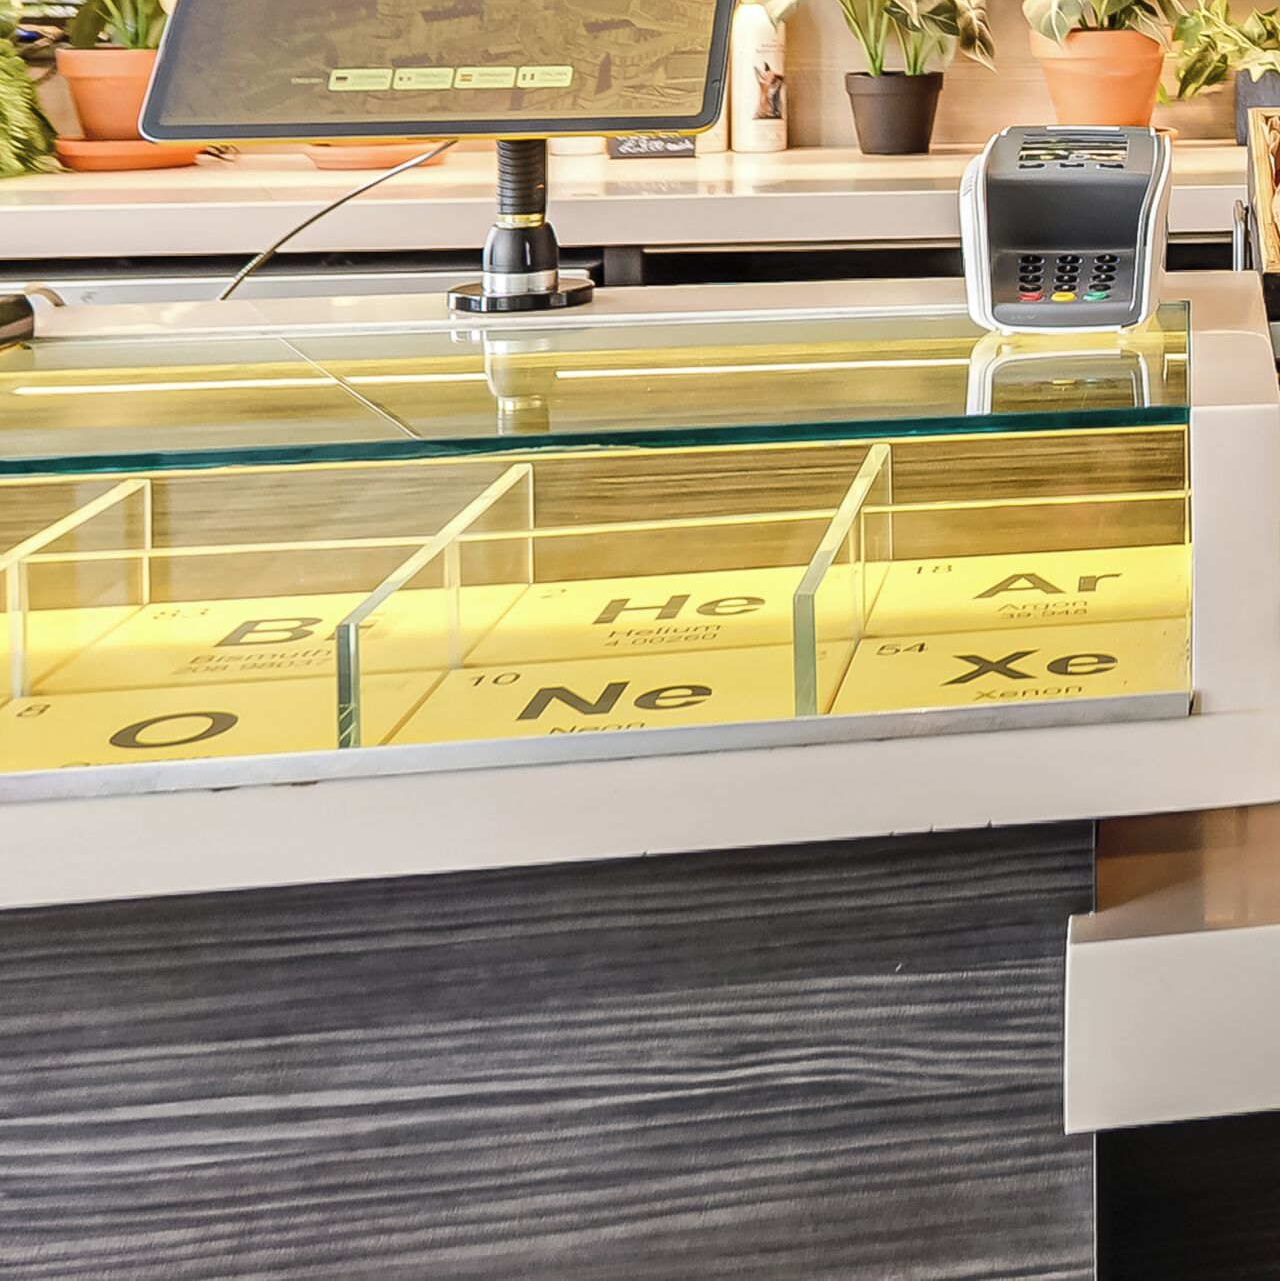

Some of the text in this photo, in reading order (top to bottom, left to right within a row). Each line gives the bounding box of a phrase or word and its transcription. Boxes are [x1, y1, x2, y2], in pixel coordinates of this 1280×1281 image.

[973, 572, 1123, 600] Ar
[592, 594, 766, 625] He
[997, 600, 1088, 612] Argon
[607, 624, 721, 638] Helium
[876, 642, 928, 656] 54
[940, 649, 1118, 687] Xe
[469, 672, 521, 687] 10
[515, 681, 712, 721] Ne
[973, 685, 1082, 701] Xenon
[109, 711, 239, 748] O
